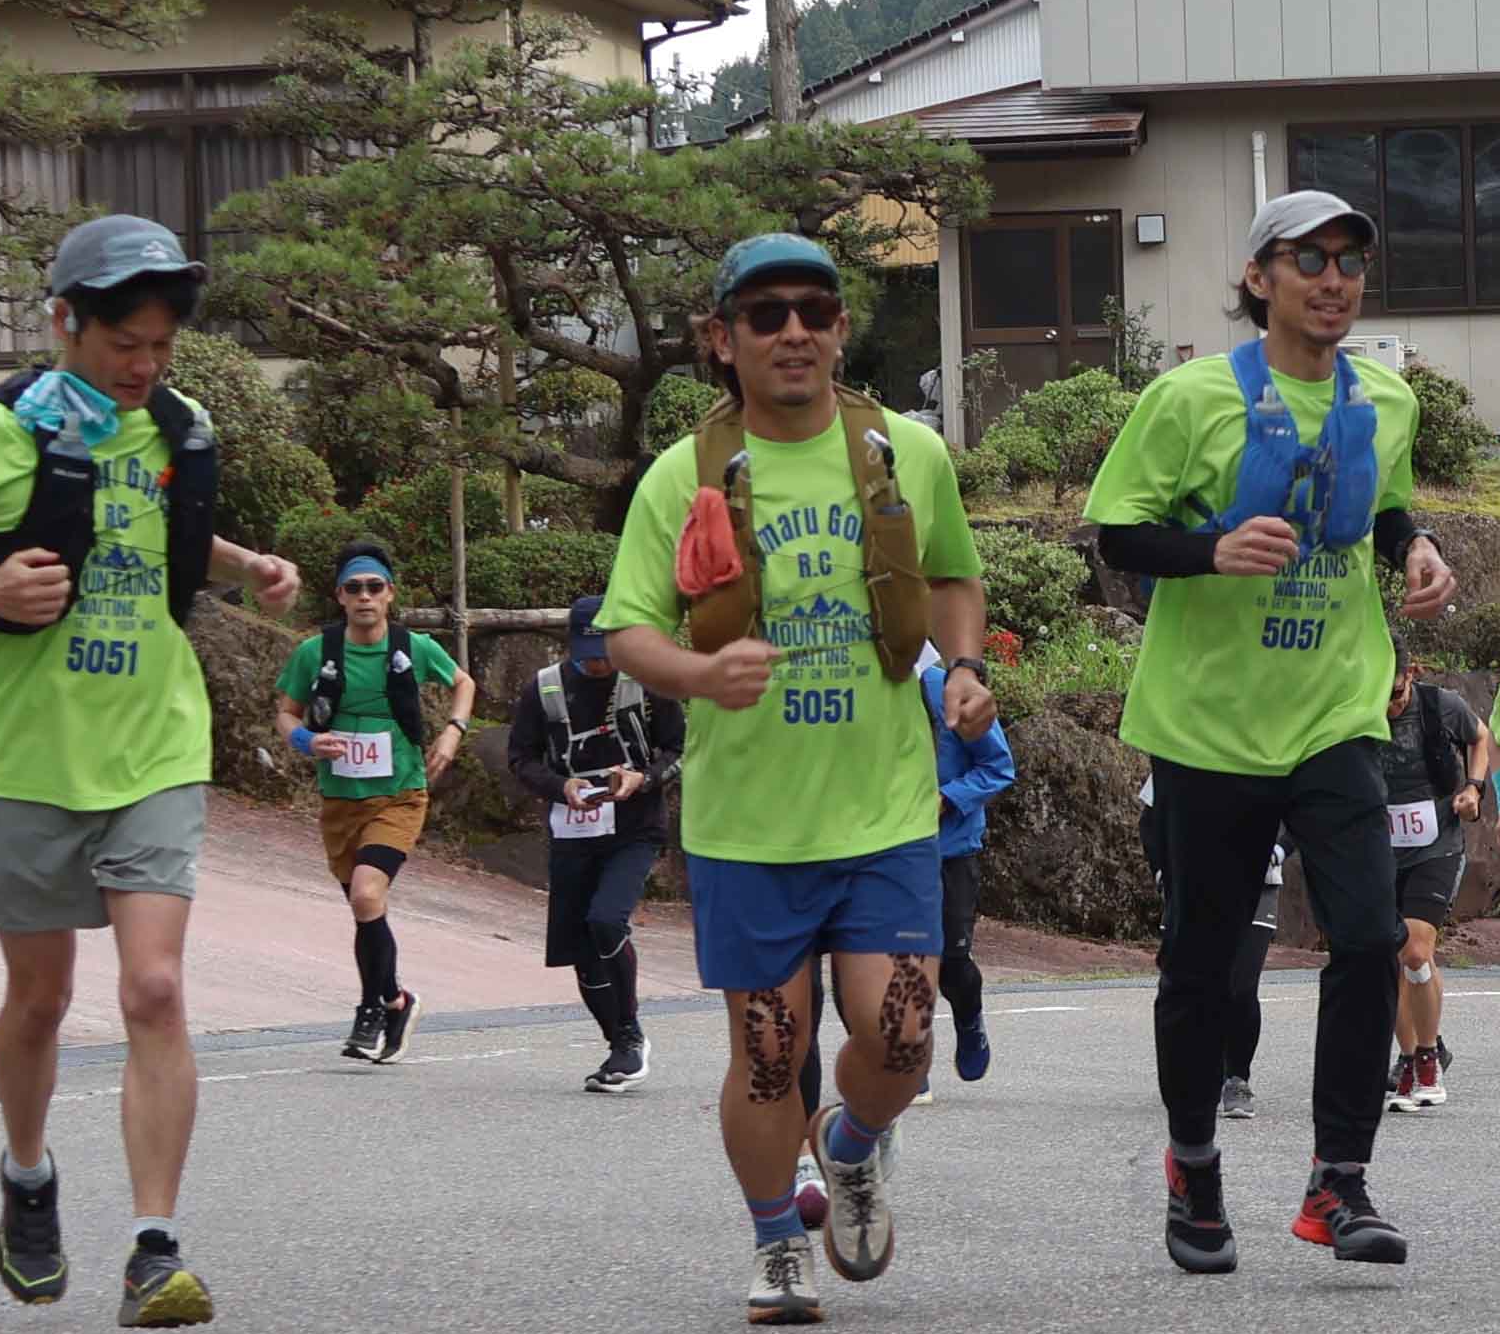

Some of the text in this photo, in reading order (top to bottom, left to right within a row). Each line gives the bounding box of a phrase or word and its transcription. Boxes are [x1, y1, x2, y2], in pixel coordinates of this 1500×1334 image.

[797, 550, 833, 578] R.C
[1276, 553, 1349, 579] UNTAINS
[761, 613, 874, 647] MOUNTAINS
[1261, 616, 1326, 651] 5051
[67, 635, 139, 676] 5051
[783, 687, 855, 725] 5051
[341, 740, 380, 765] 104
[1387, 810, 1424, 836] 115
